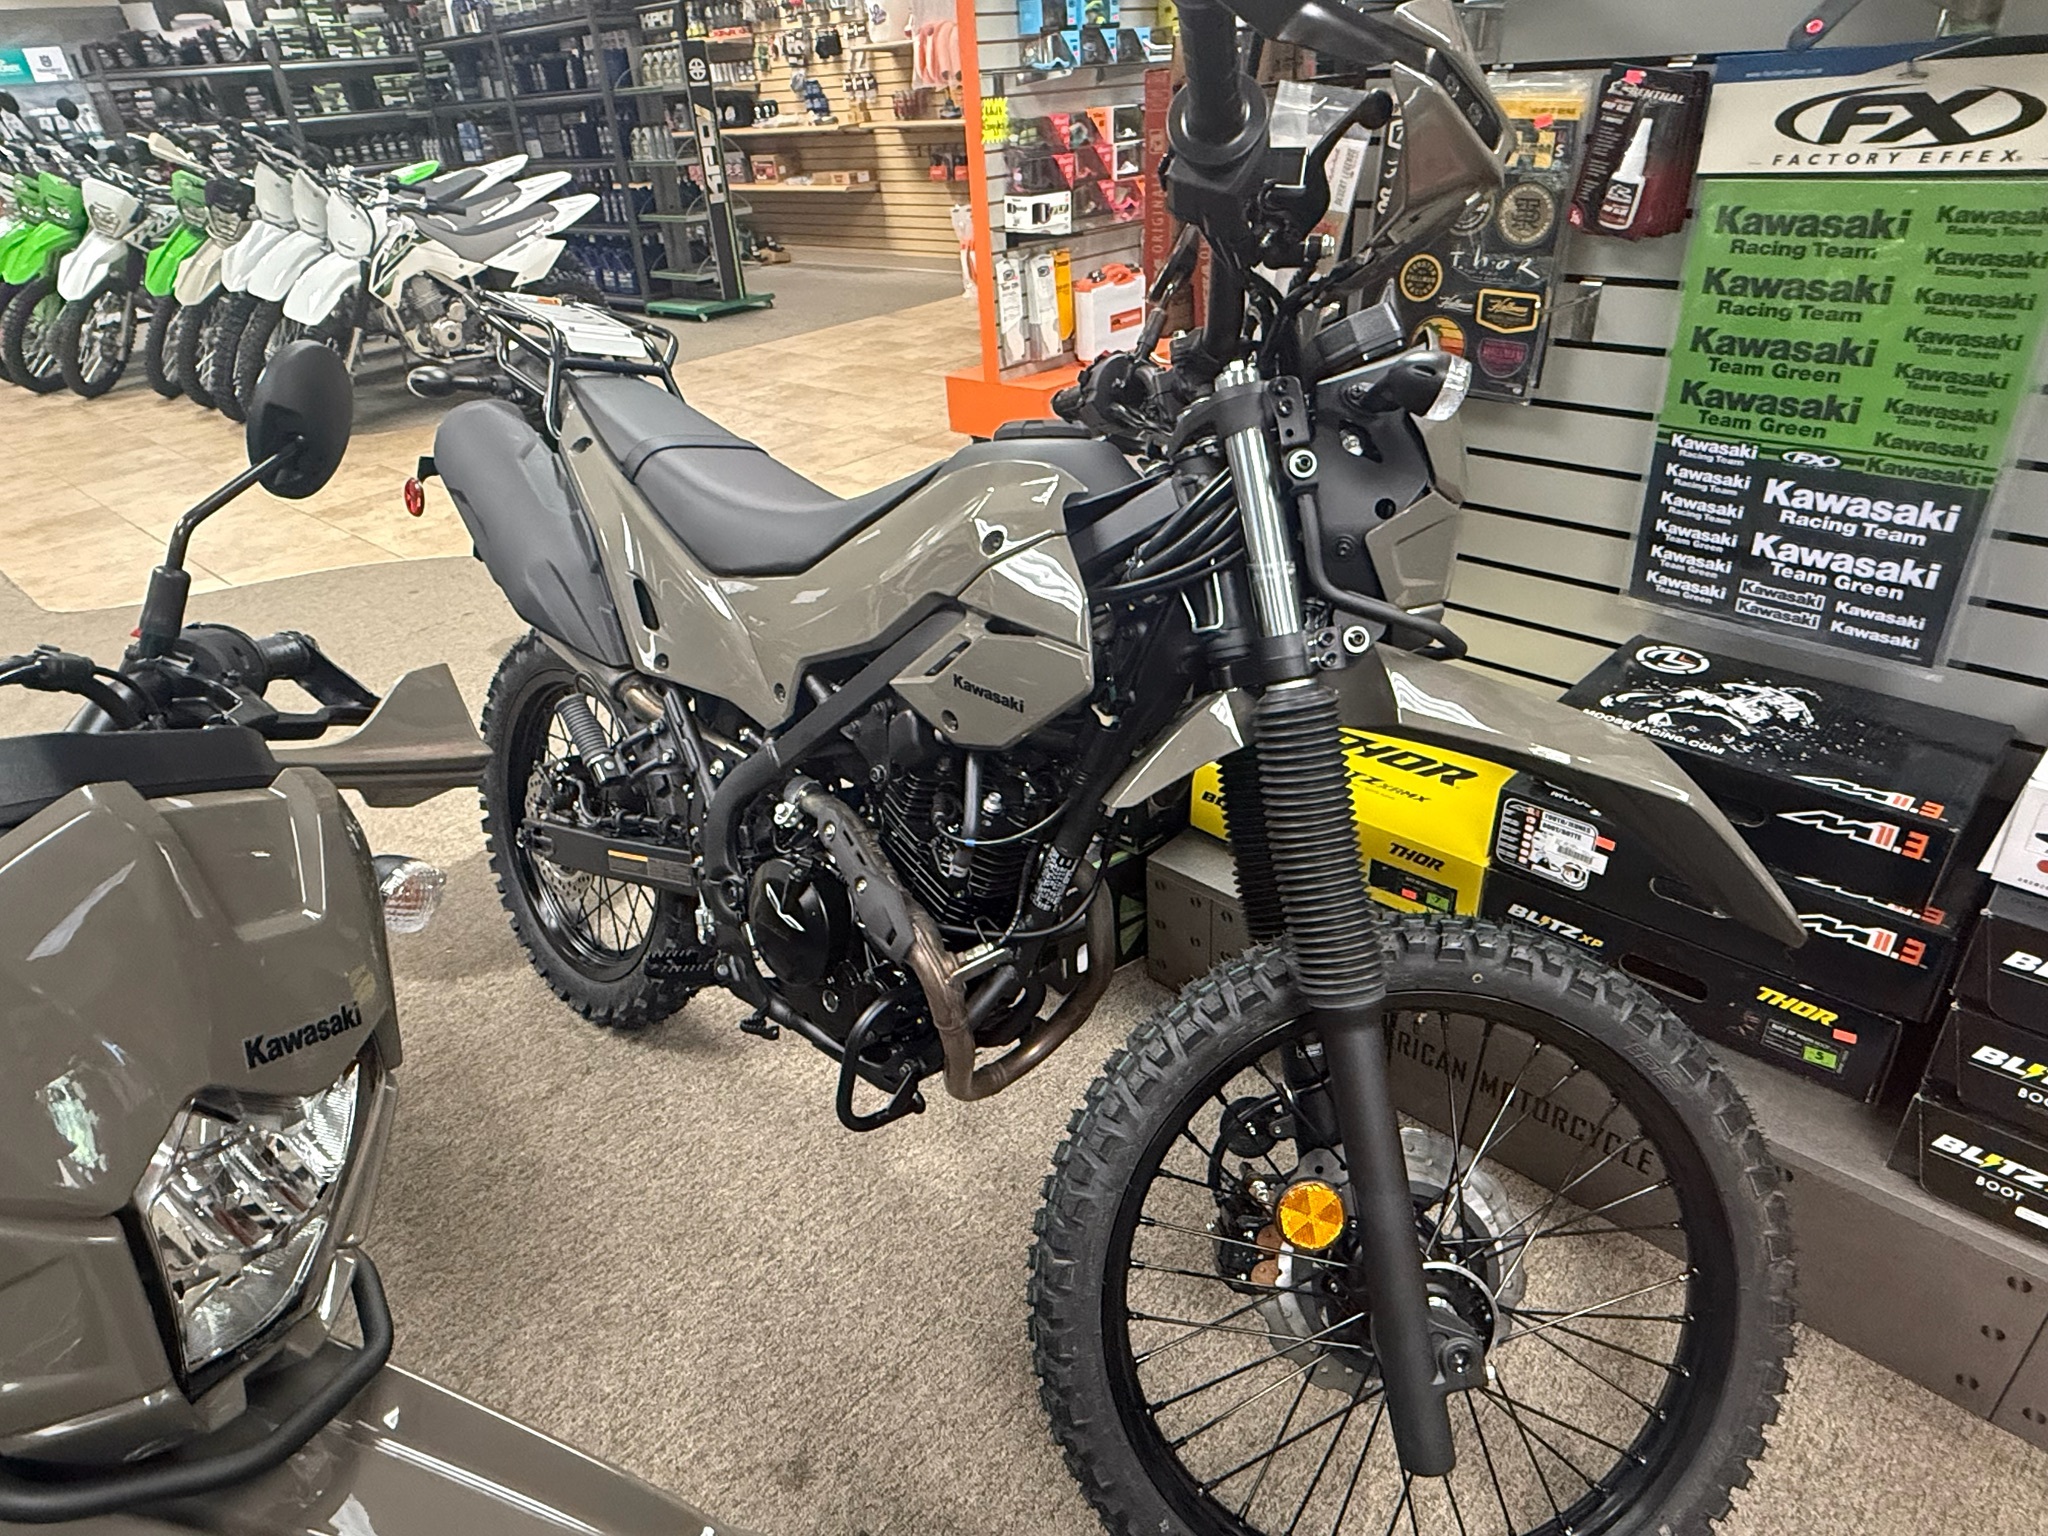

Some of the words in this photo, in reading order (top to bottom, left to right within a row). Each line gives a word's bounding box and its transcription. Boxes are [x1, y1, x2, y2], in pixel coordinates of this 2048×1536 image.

[1816, 89, 2000, 145] FX
[1771, 151, 1901, 167] FACTORY
[1919, 150, 2017, 165] EFFEX
[1714, 205, 1914, 240] Kawasaki
[1935, 205, 2048, 225] Kawasak
[1729, 239, 1806, 260] Racing
[1813, 242, 1878, 259] Team
[1924, 248, 2048, 269] Kawasaki
[1702, 267, 1896, 305] Kawasaki
[1914, 287, 2038, 310] Kawasaki
[1717, 300, 1793, 321] Racing
[1798, 304, 1863, 323] Team
[1689, 326, 1880, 367] Kawasaki
[1903, 326, 2024, 351] Kawasaki
[1708, 356, 1764, 377] Team
[1771, 362, 1841, 384] Green
[1894, 362, 2012, 389] Kawasaki
[1679, 379, 1864, 424] Kawasaki
[1884, 397, 1999, 425] Kawasaki
[1699, 409, 1751, 430] Team
[1759, 417, 1827, 439] Green
[1671, 433, 1759, 460] Kawasaki
[1873, 431, 1989, 460] Kawasaki
[1665, 462, 1752, 490] Kawasaki
[1864, 456, 1977, 485] Kawasaki
[1660, 491, 1745, 520] Kawasaki
[1763, 478, 1962, 534] Kawasaki
[1655, 519, 1739, 548] Kawasaki
[1779, 509, 1858, 537] Racing
[1861, 522, 1927, 547] Team
[1650, 544, 1733, 574] Kawasaki
[1750, 532, 1943, 591] Kawasaki
[1645, 569, 1728, 600] Kawasaki
[1742, 581, 1824, 609] Kawasaki
[1771, 561, 1828, 587] Team
[1834, 575, 1906, 602] Green
[1738, 600, 1819, 628] Kawasaki
[1835, 601, 1927, 631] Kawasaki
[1830, 620, 1920, 650] Kawasaki
[953, 673, 1025, 714] Kawasaki
[1389, 842, 1445, 873] THOR
[1507, 903, 1583, 940] BLITZ
[1756, 985, 1839, 1027] THOR
[244, 1001, 362, 1069] Kawasaki
[1396, 1031, 1468, 1083] RICAN
[1480, 1070, 1655, 1175] MOTORCYCLE
[2017, 1087, 2048, 1108] BOO
[1975, 1175, 2025, 1201] BOOT
